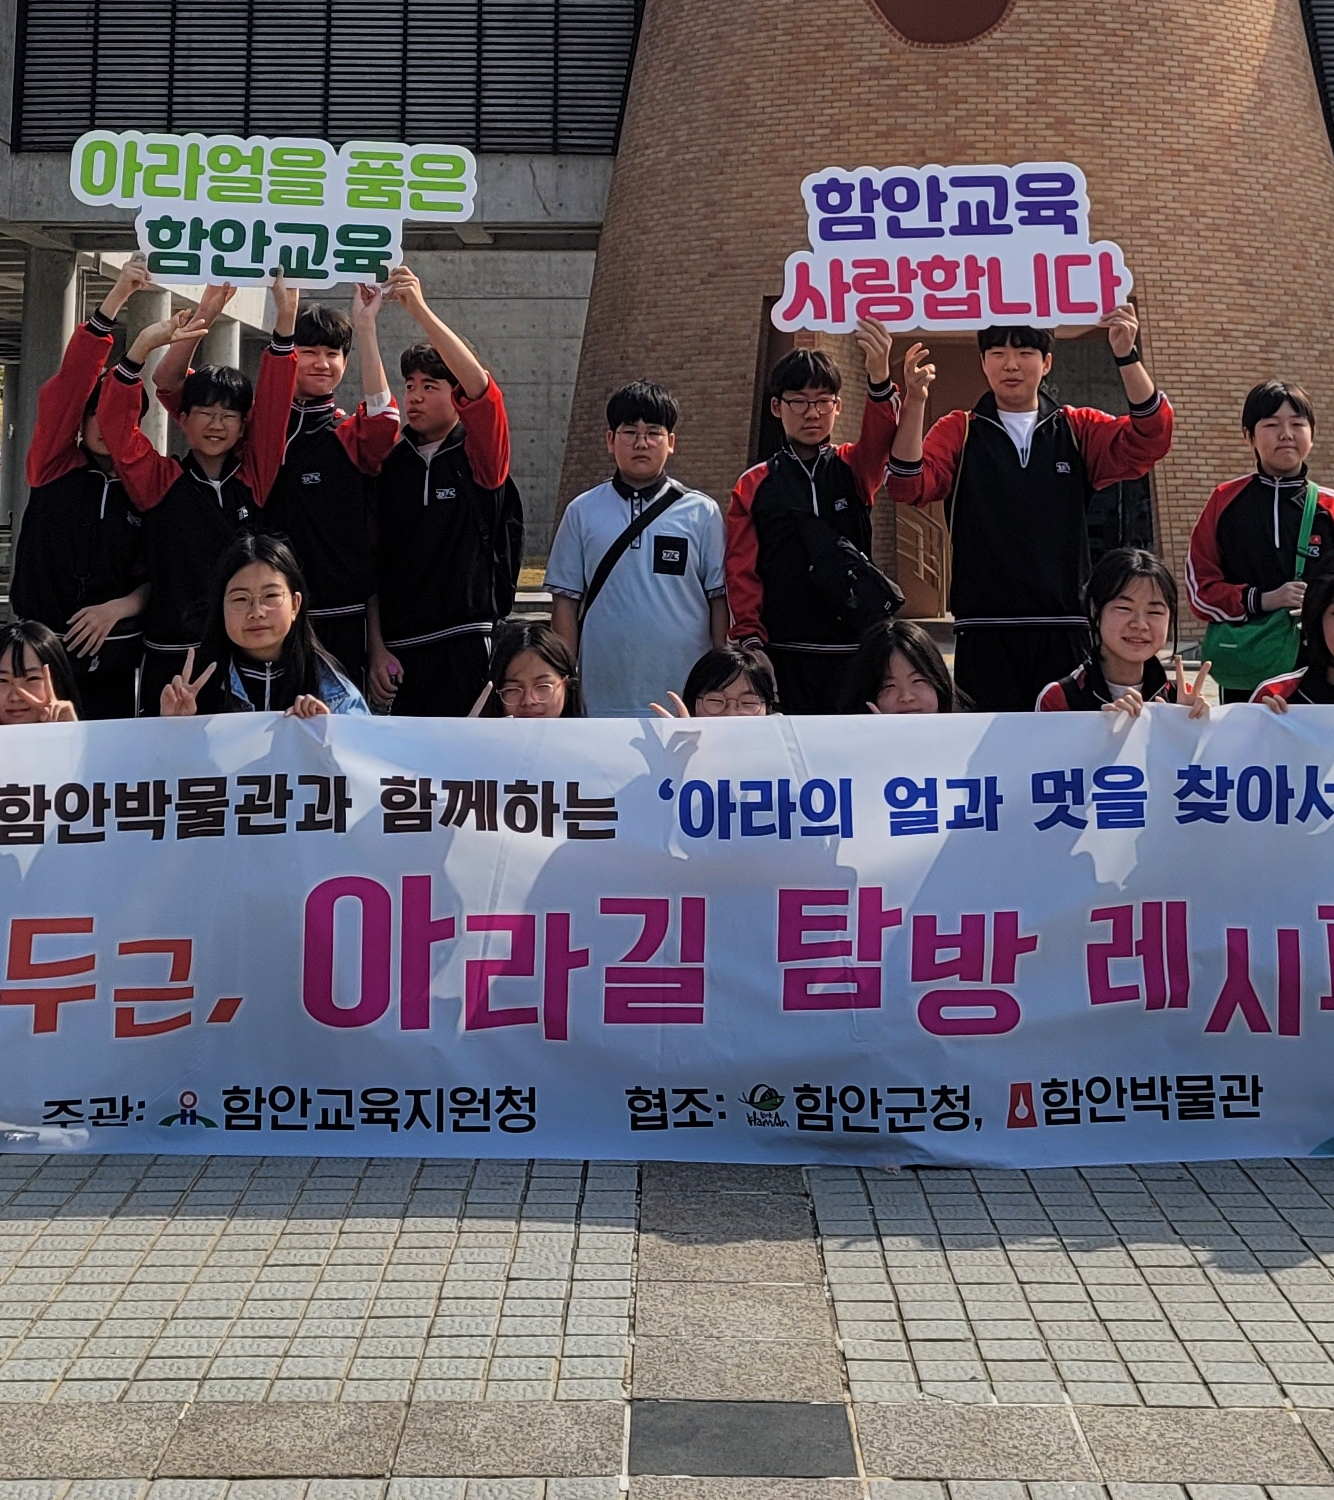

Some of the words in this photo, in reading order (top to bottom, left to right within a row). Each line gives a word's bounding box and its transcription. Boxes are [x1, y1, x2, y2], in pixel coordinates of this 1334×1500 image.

[79, 139, 328, 207] 아라얼을
[345, 150, 468, 213] 품은
[811, 172, 1079, 242] 함안교육
[145, 214, 394, 284] 함안교육
[781, 251, 1123, 324] 사랑합니다
[378, 775, 620, 840] 함께하는
[657, 776, 854, 841] ‘아라의
[882, 776, 1004, 837] 얼과
[1030, 765, 1149, 832] 멋을
[302, 874, 707, 1042] 아라길
[777, 886, 1039, 1037] 탐방
[41, 1095, 145, 1130] 주관:
[221, 1085, 537, 1134] 함안교육지원청
[624, 1084, 727, 1133] 협조:
[792, 1082, 983, 1134] 함안군청,
[1039, 1073, 1264, 1127] 함안박물관
